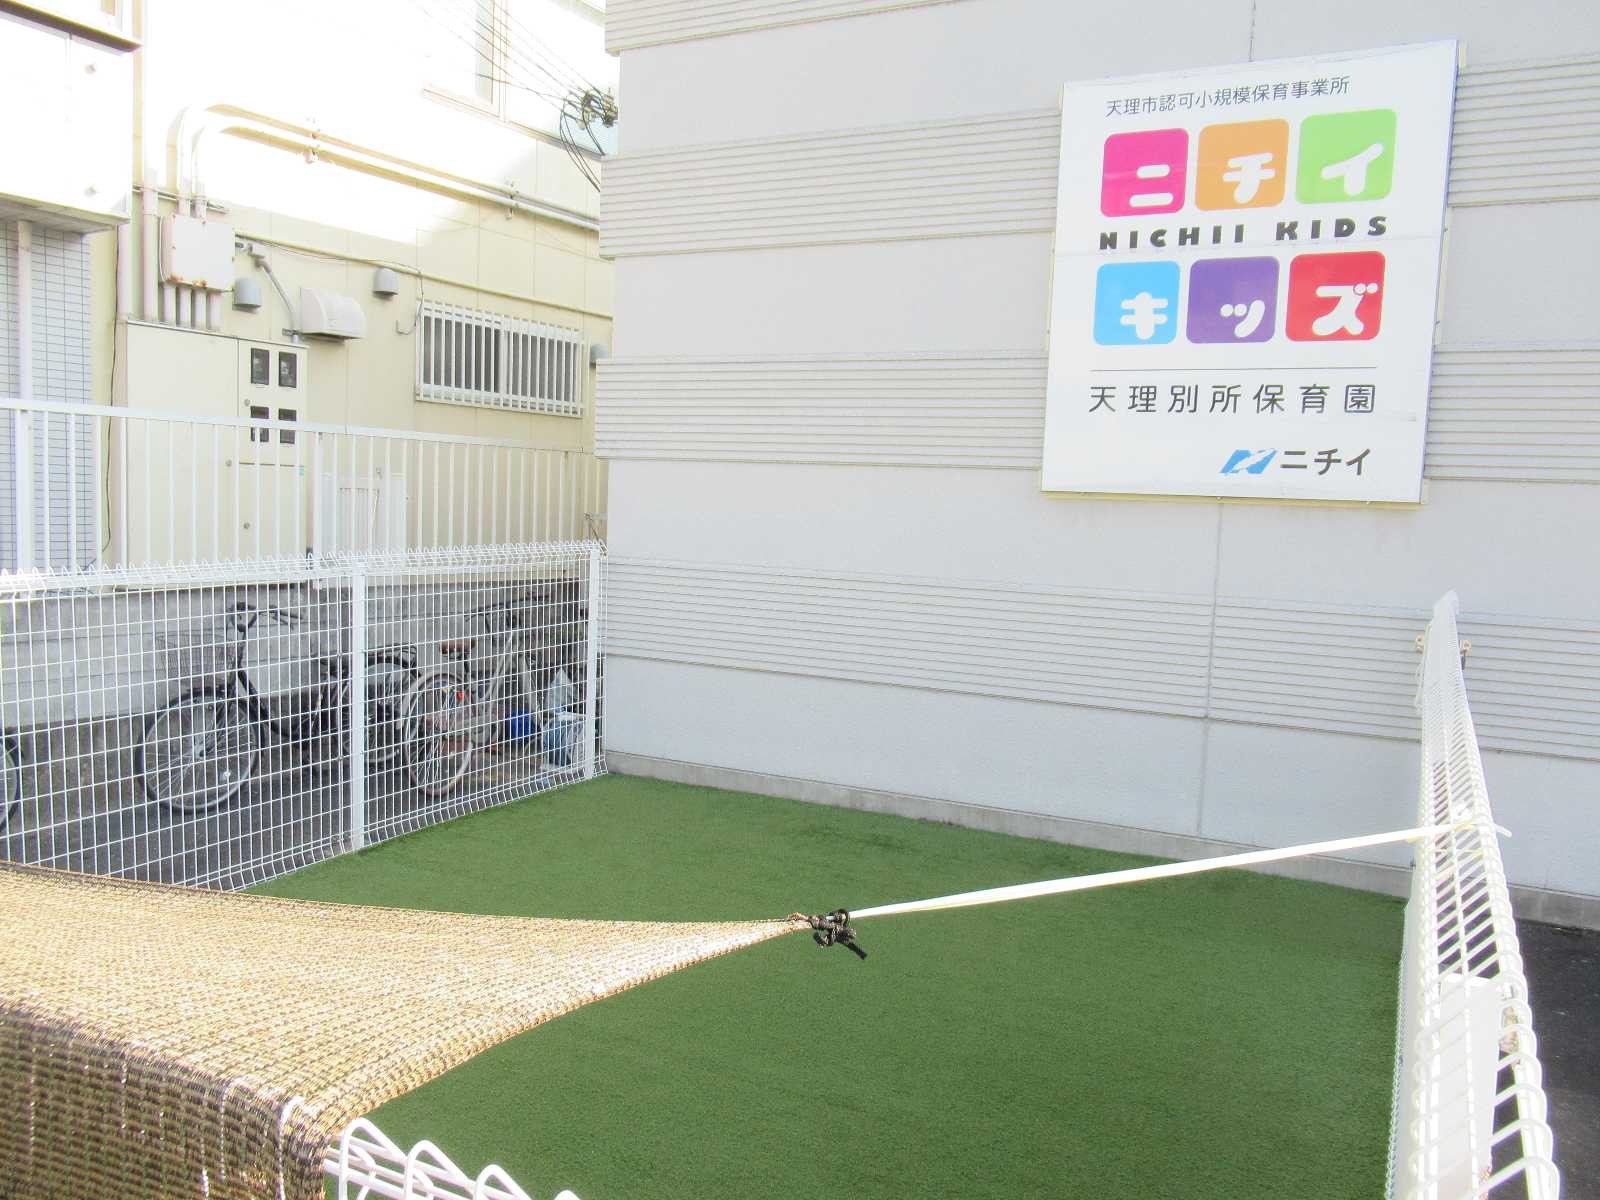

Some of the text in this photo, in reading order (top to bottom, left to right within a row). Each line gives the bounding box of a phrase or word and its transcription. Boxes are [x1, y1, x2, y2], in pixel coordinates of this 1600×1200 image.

[1106, 76, 1350, 116] 天理市認可小規模保育事業所
[1128, 142, 1386, 208] ニチイ
[1099, 216, 1388, 250] NICHII KIDS
[1120, 281, 1380, 340] キッズ
[1088, 384, 1377, 414] 天理別所保育園
[1280, 448, 1371, 476] ニチイ
